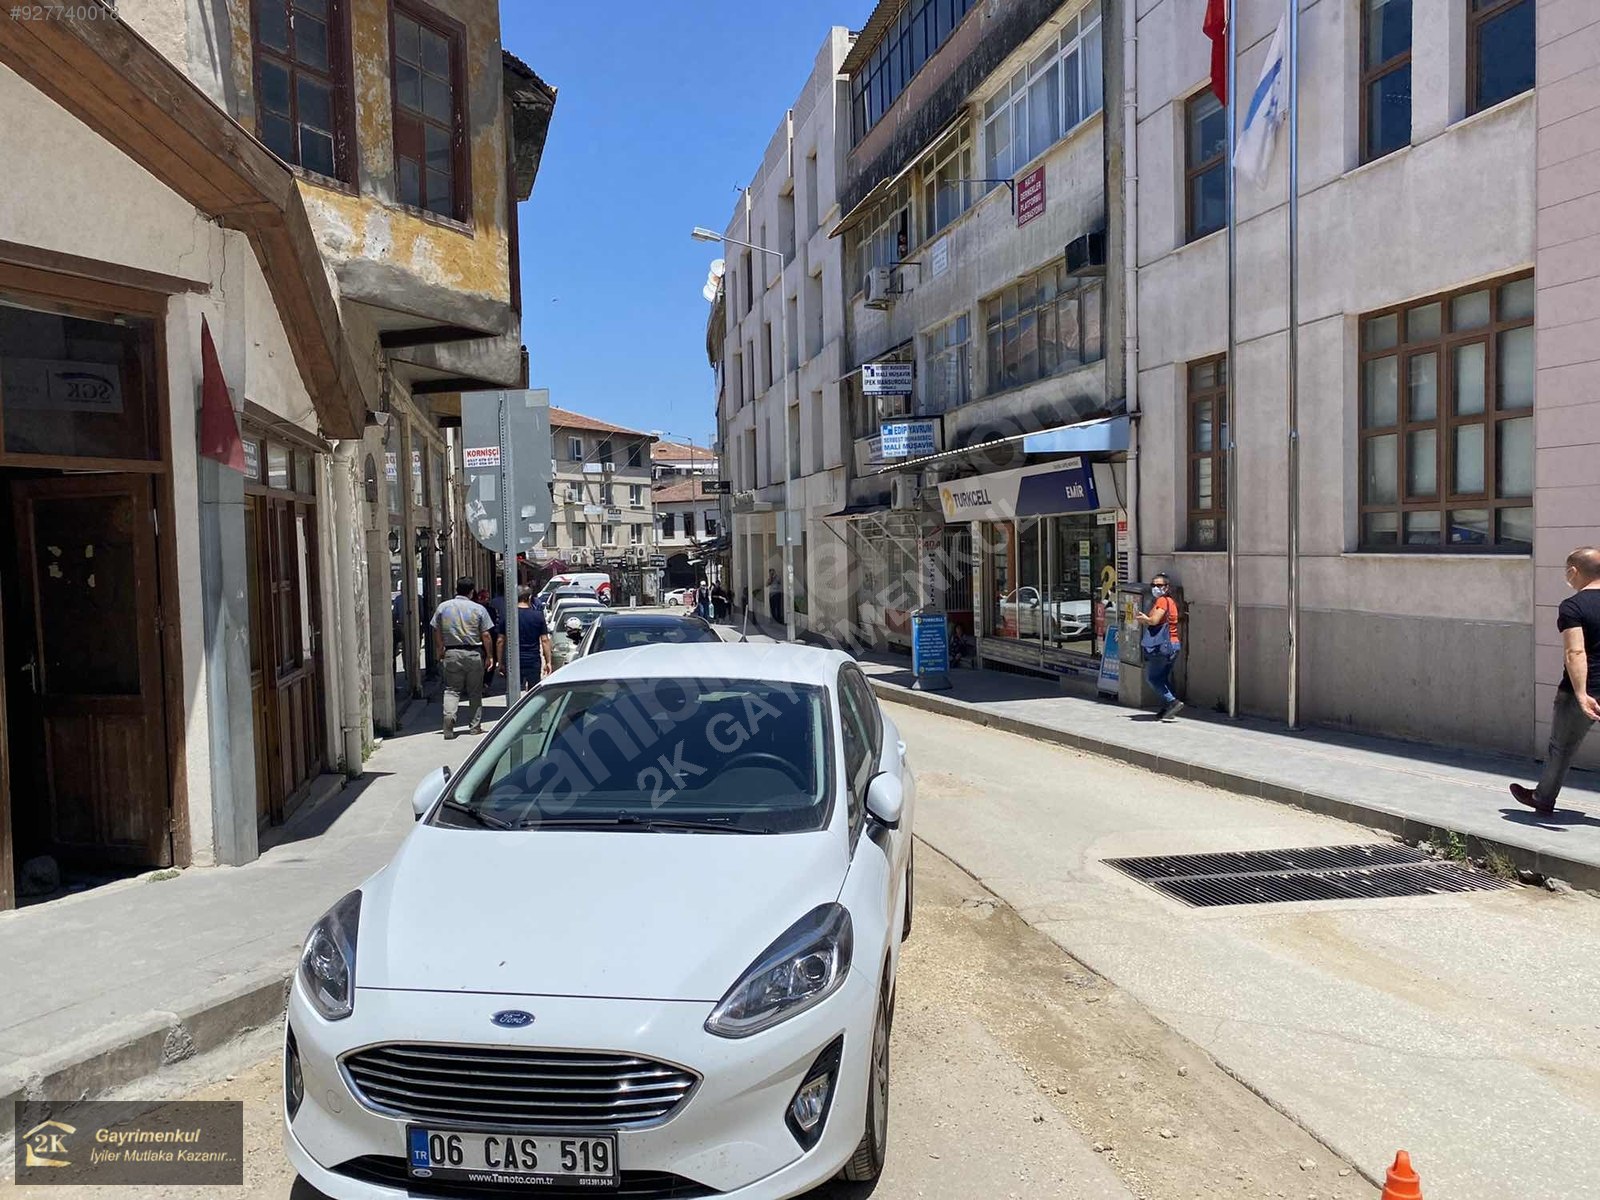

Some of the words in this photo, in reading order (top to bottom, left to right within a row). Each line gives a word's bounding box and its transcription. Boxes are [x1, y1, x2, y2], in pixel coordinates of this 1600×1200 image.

[952, 488, 992, 508] TURKCELL
[1065, 481, 1084, 499] EMİR
[415, 1150, 428, 1161] TR
[429, 1133, 465, 1166] 06
[484, 1137, 539, 1170] CAS
[560, 1140, 610, 1173] 519
[468, 1173, 554, 1186] www.Tanoto.com.tr
